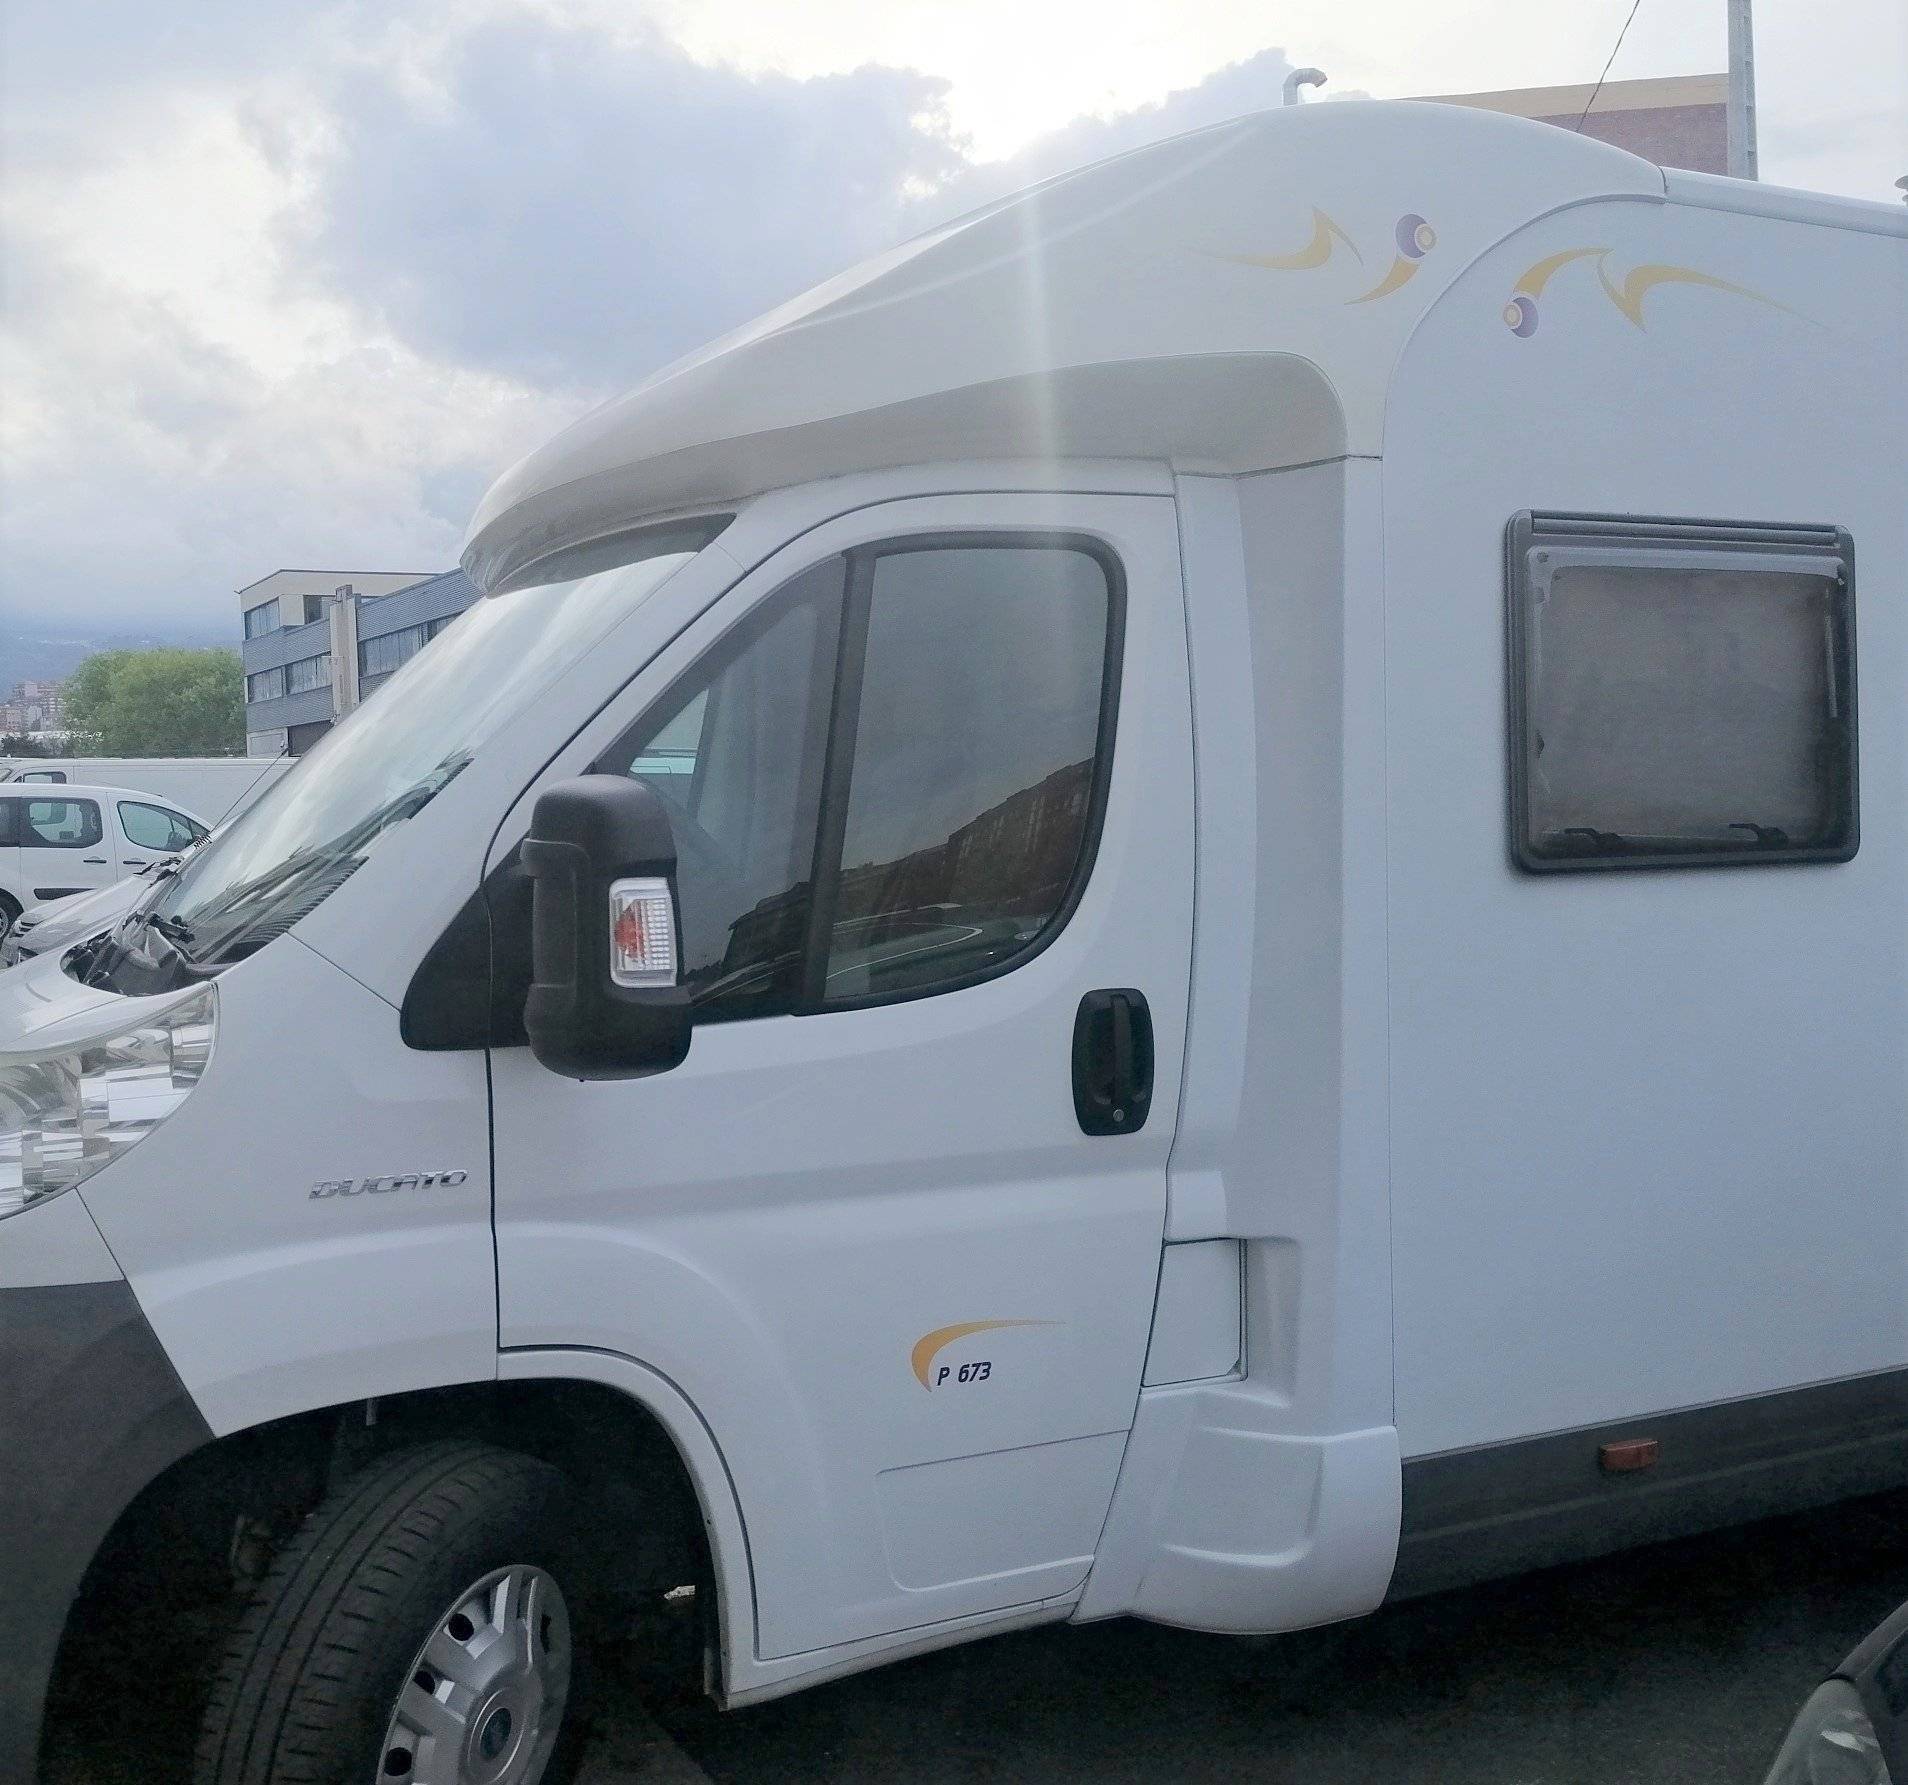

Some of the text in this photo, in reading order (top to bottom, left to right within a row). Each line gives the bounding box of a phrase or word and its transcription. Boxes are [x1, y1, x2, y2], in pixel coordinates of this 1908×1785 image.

[309, 1170, 468, 1200] DUCATO
[937, 1361, 992, 1386] P 673
